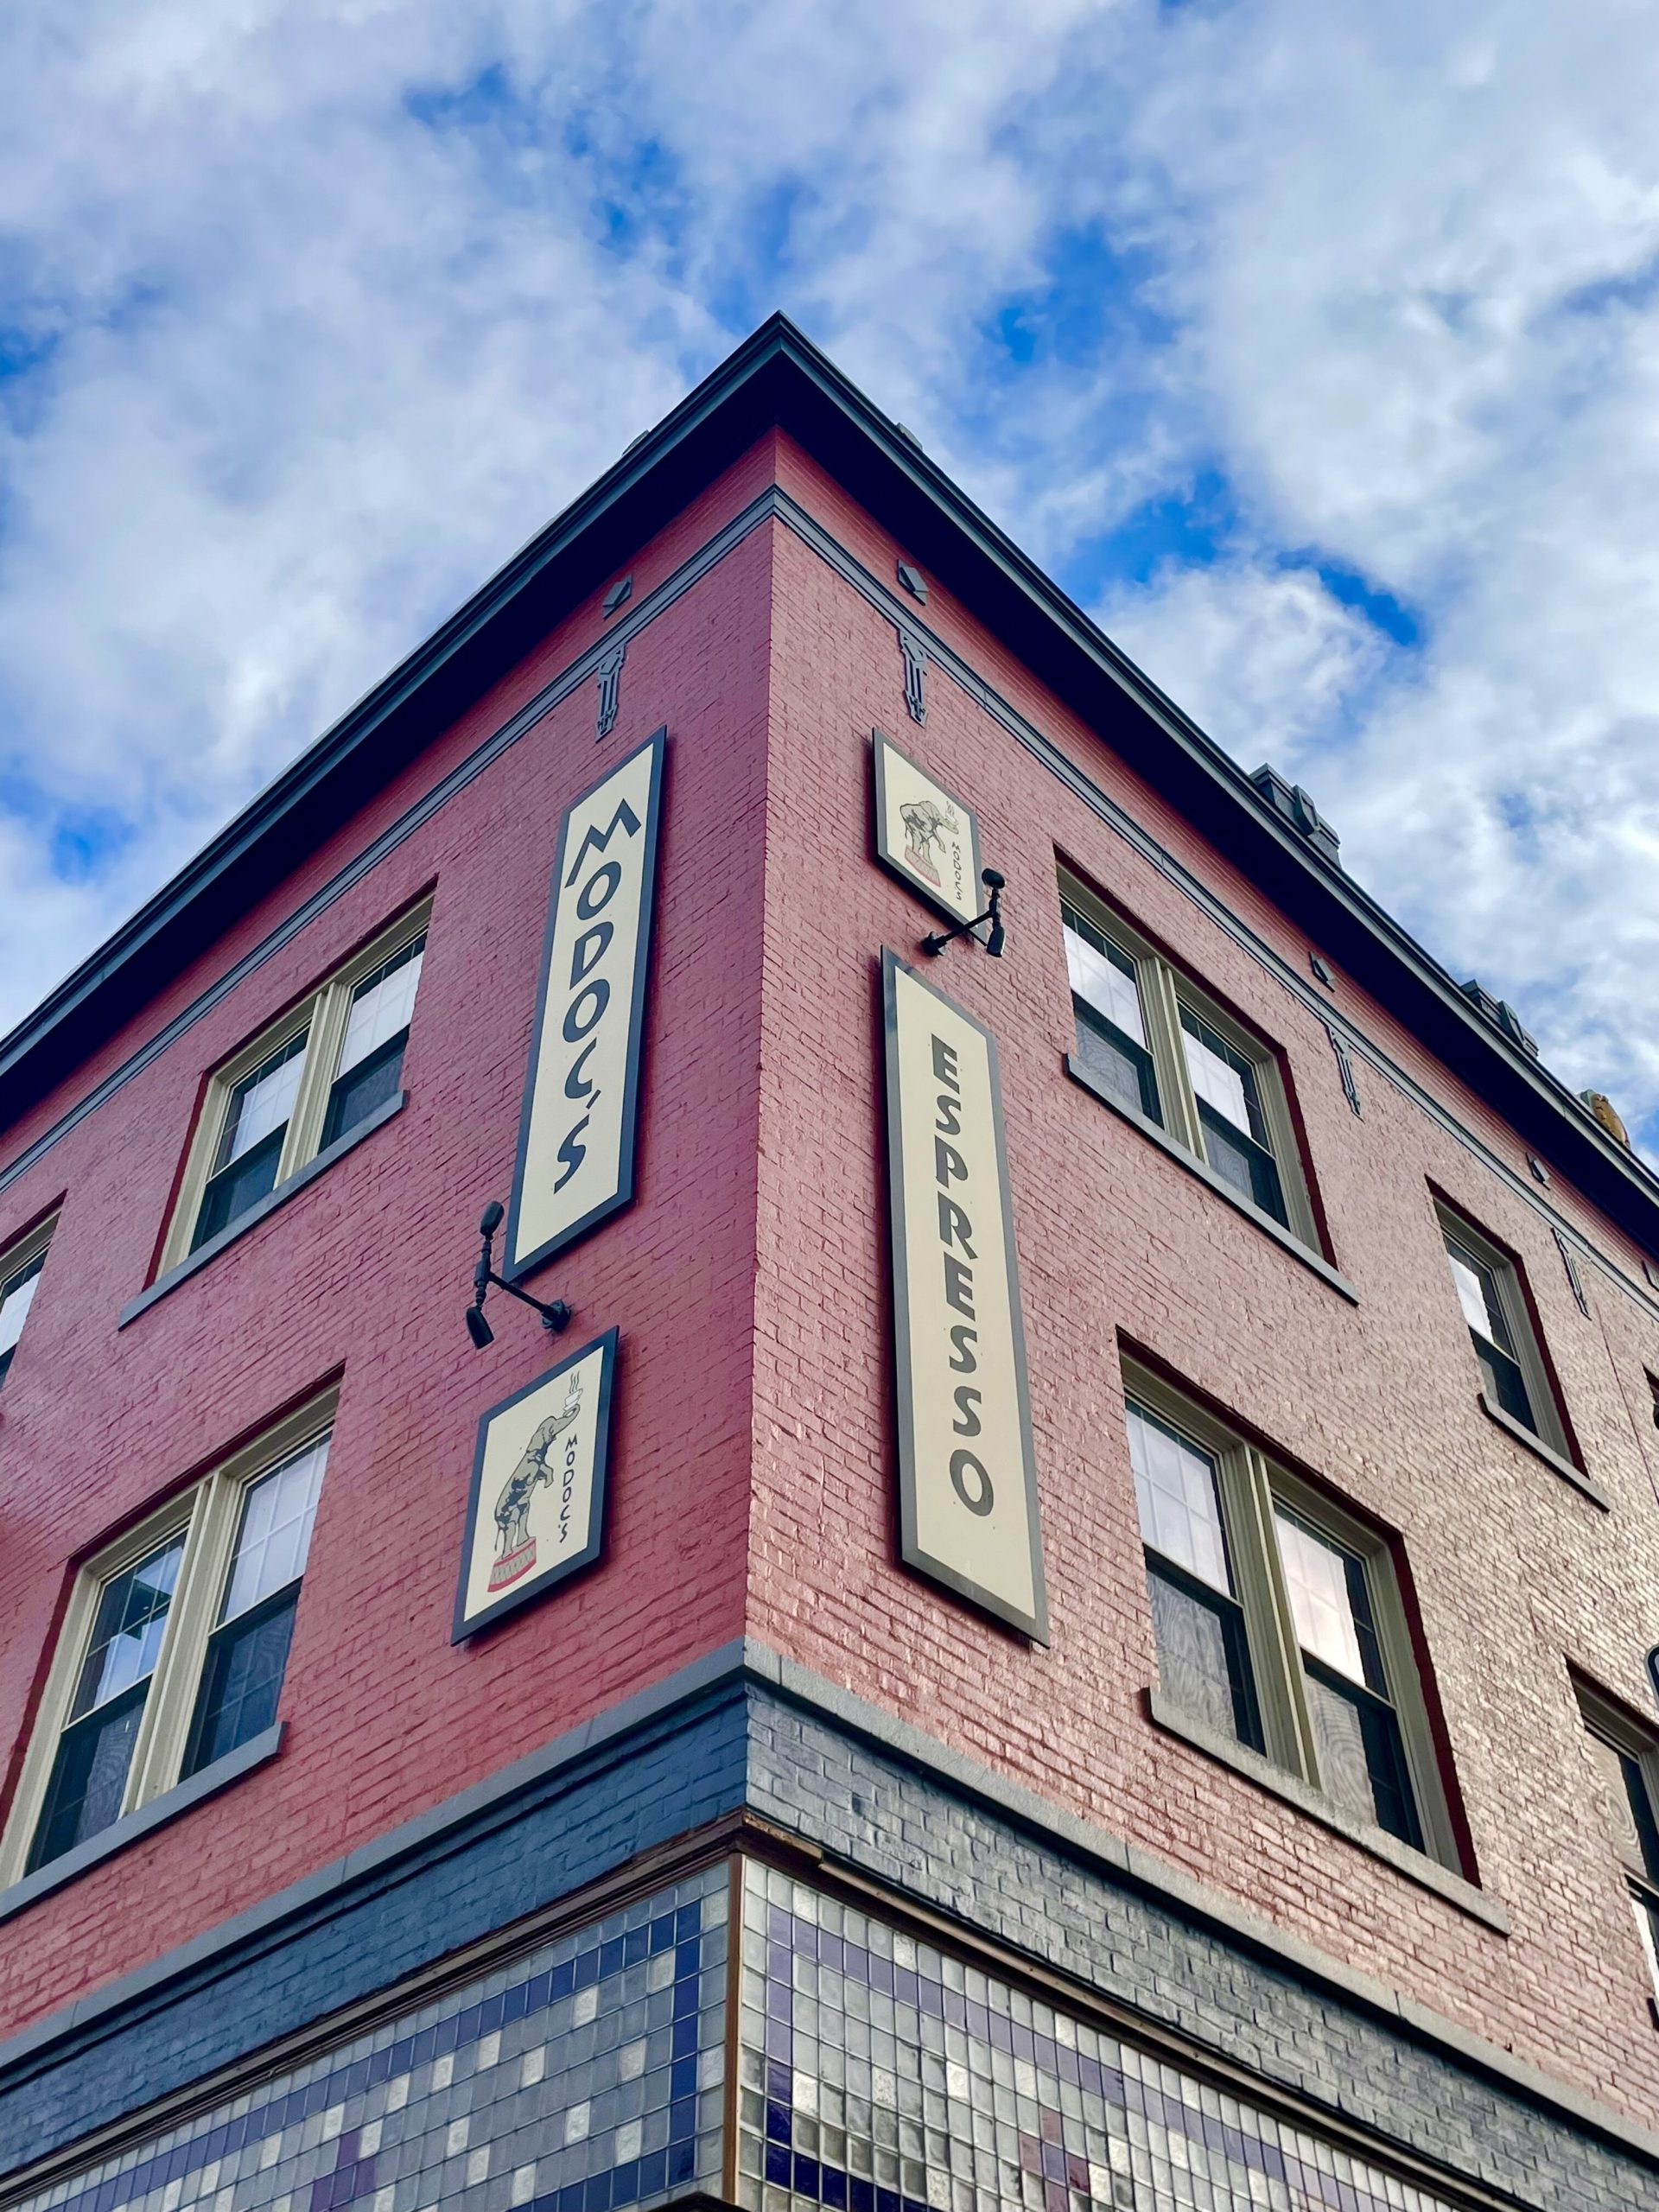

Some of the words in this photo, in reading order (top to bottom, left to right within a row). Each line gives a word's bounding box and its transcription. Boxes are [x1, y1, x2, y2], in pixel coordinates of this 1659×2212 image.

[553, 798, 642, 1194] MODOC'S
[931, 1032, 995, 1517] ESPRESSO
[558, 1434, 578, 1543] MODOC'S
